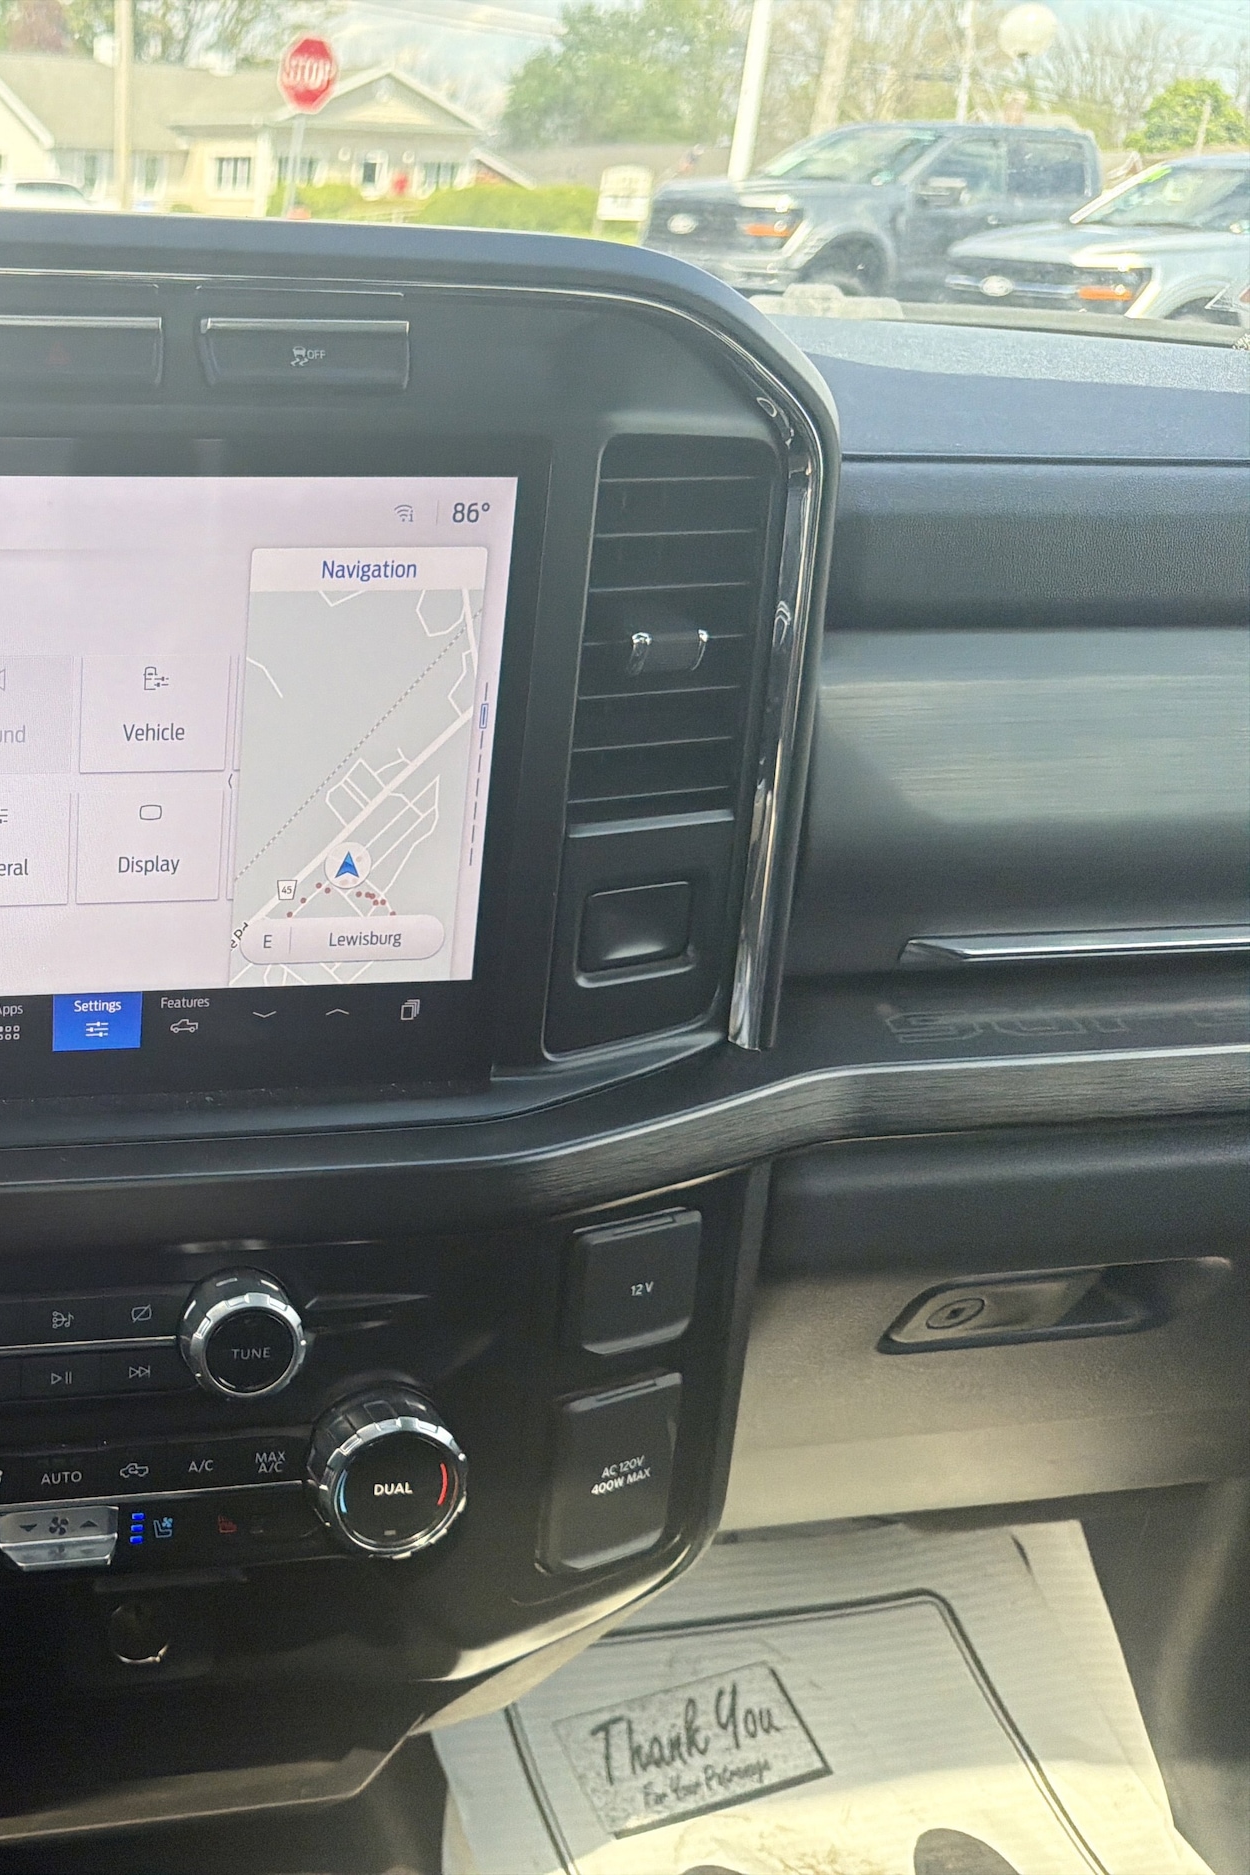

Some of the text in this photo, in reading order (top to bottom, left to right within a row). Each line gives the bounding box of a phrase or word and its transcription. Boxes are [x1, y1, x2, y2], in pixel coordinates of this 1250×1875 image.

[282, 56, 331, 90] STOP
[307, 349, 325, 359] OFF
[320, 559, 417, 582] Navigation
[122, 722, 185, 742] Vehicle
[117, 855, 180, 875] Display
[280, 884, 292, 896] 45
[263, 934, 272, 949] E
[328, 930, 402, 949] Lewisburg
[72, 997, 122, 1013] Settings
[161, 996, 210, 1009] Features
[630, 1281, 654, 1296] 12 V
[231, 1346, 271, 1360] TUNE
[254, 1450, 286, 1463] MAX
[187, 1458, 214, 1473] A/C
[257, 1460, 283, 1474] A/C
[601, 1455, 645, 1479] AC 120V
[40, 1470, 83, 1485] AUTO
[590, 1466, 651, 1495] 400W MAX
[373, 1482, 413, 1496] DUAL
[590, 1682, 780, 1786] Thank You
